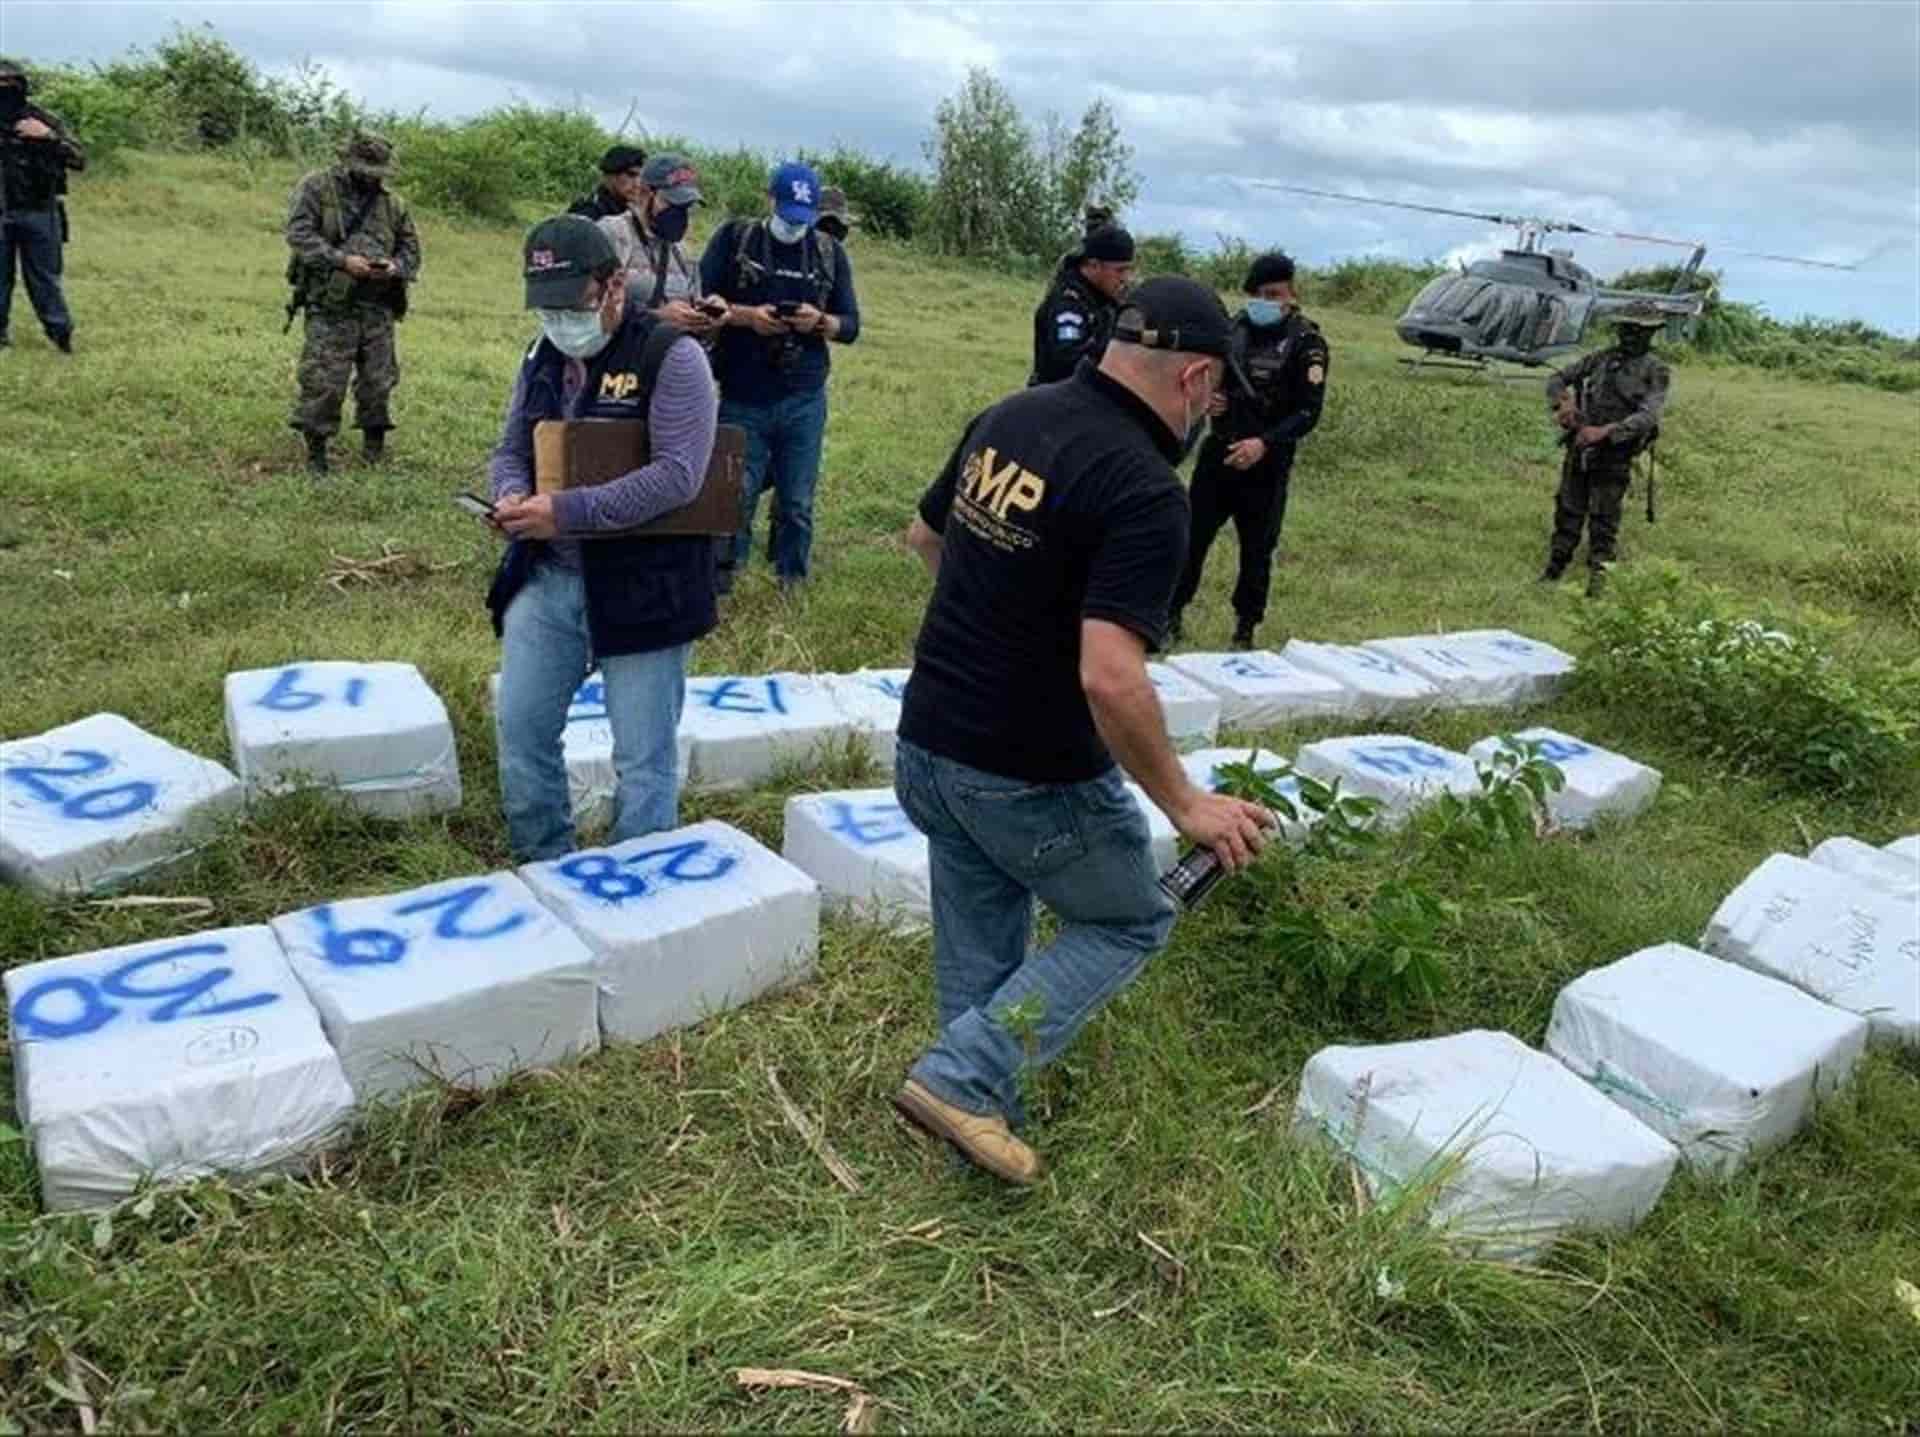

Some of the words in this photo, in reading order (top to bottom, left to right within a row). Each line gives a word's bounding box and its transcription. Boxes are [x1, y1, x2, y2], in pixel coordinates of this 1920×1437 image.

[600, 372, 638, 399] MP
[963, 447, 1045, 520] MP
[254, 668, 371, 712] 19
[691, 678, 788, 716] 17
[3, 750, 158, 820] 20
[558, 840, 737, 903] 28
[310, 885, 526, 967] 29
[12, 944, 280, 1040] 30
